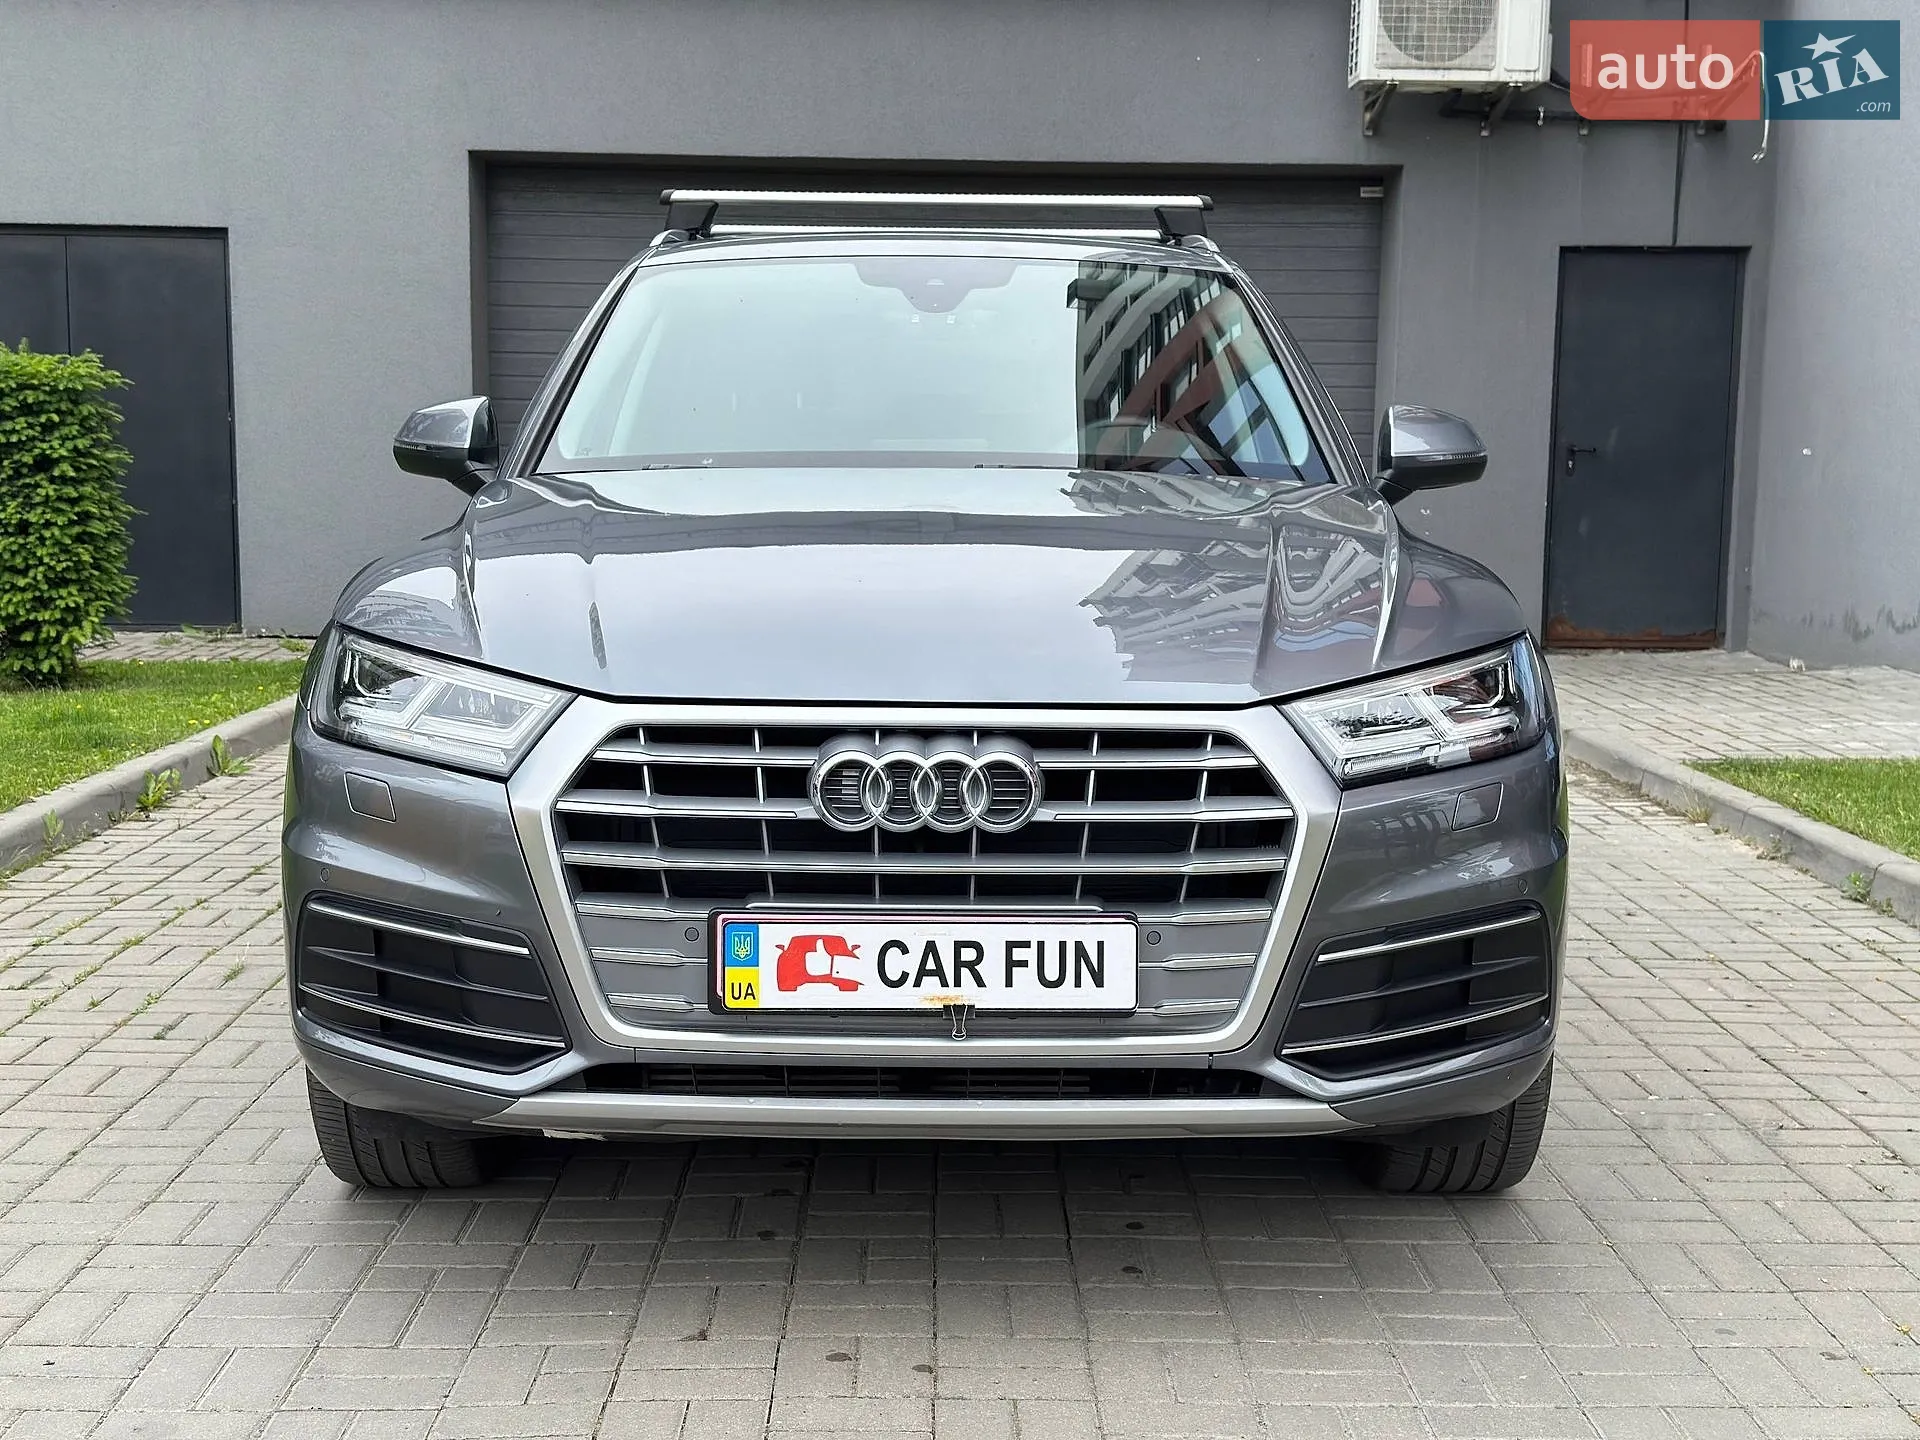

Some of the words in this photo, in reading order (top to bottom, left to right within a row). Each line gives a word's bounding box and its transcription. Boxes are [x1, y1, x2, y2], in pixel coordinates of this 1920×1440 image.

[876, 939, 987, 988] CAR
[1005, 940, 1106, 989] FUN
[730, 982, 757, 1001] UA
